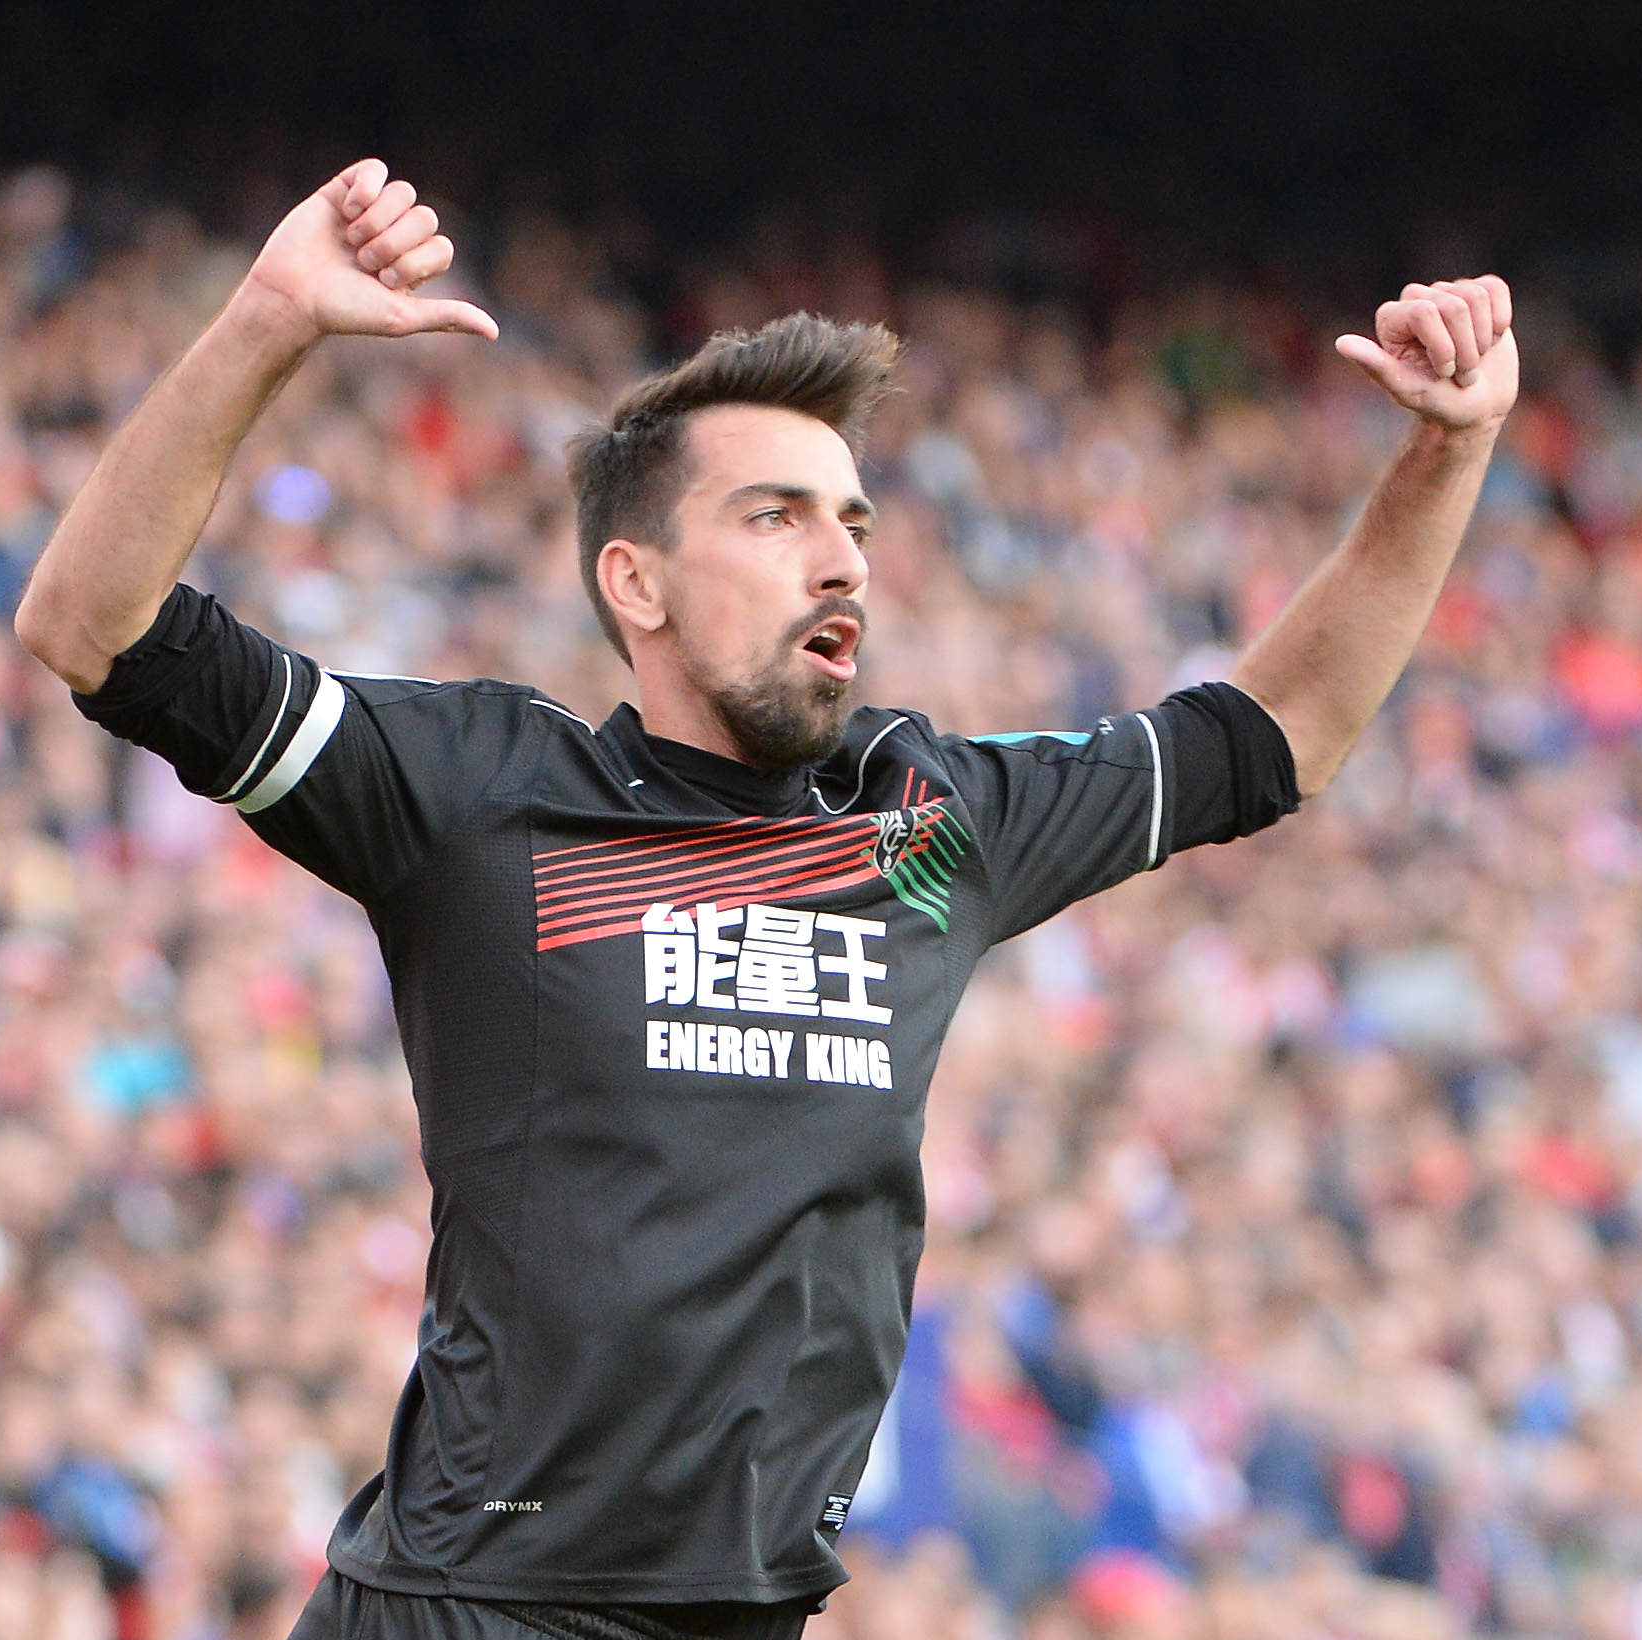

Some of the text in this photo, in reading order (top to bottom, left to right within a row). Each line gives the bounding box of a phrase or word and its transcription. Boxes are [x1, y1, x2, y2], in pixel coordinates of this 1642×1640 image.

[641, 902, 894, 1025] 能量王
[646, 1020, 893, 1090] ENERGY KING
[483, 1500, 543, 1512] DRYMX
